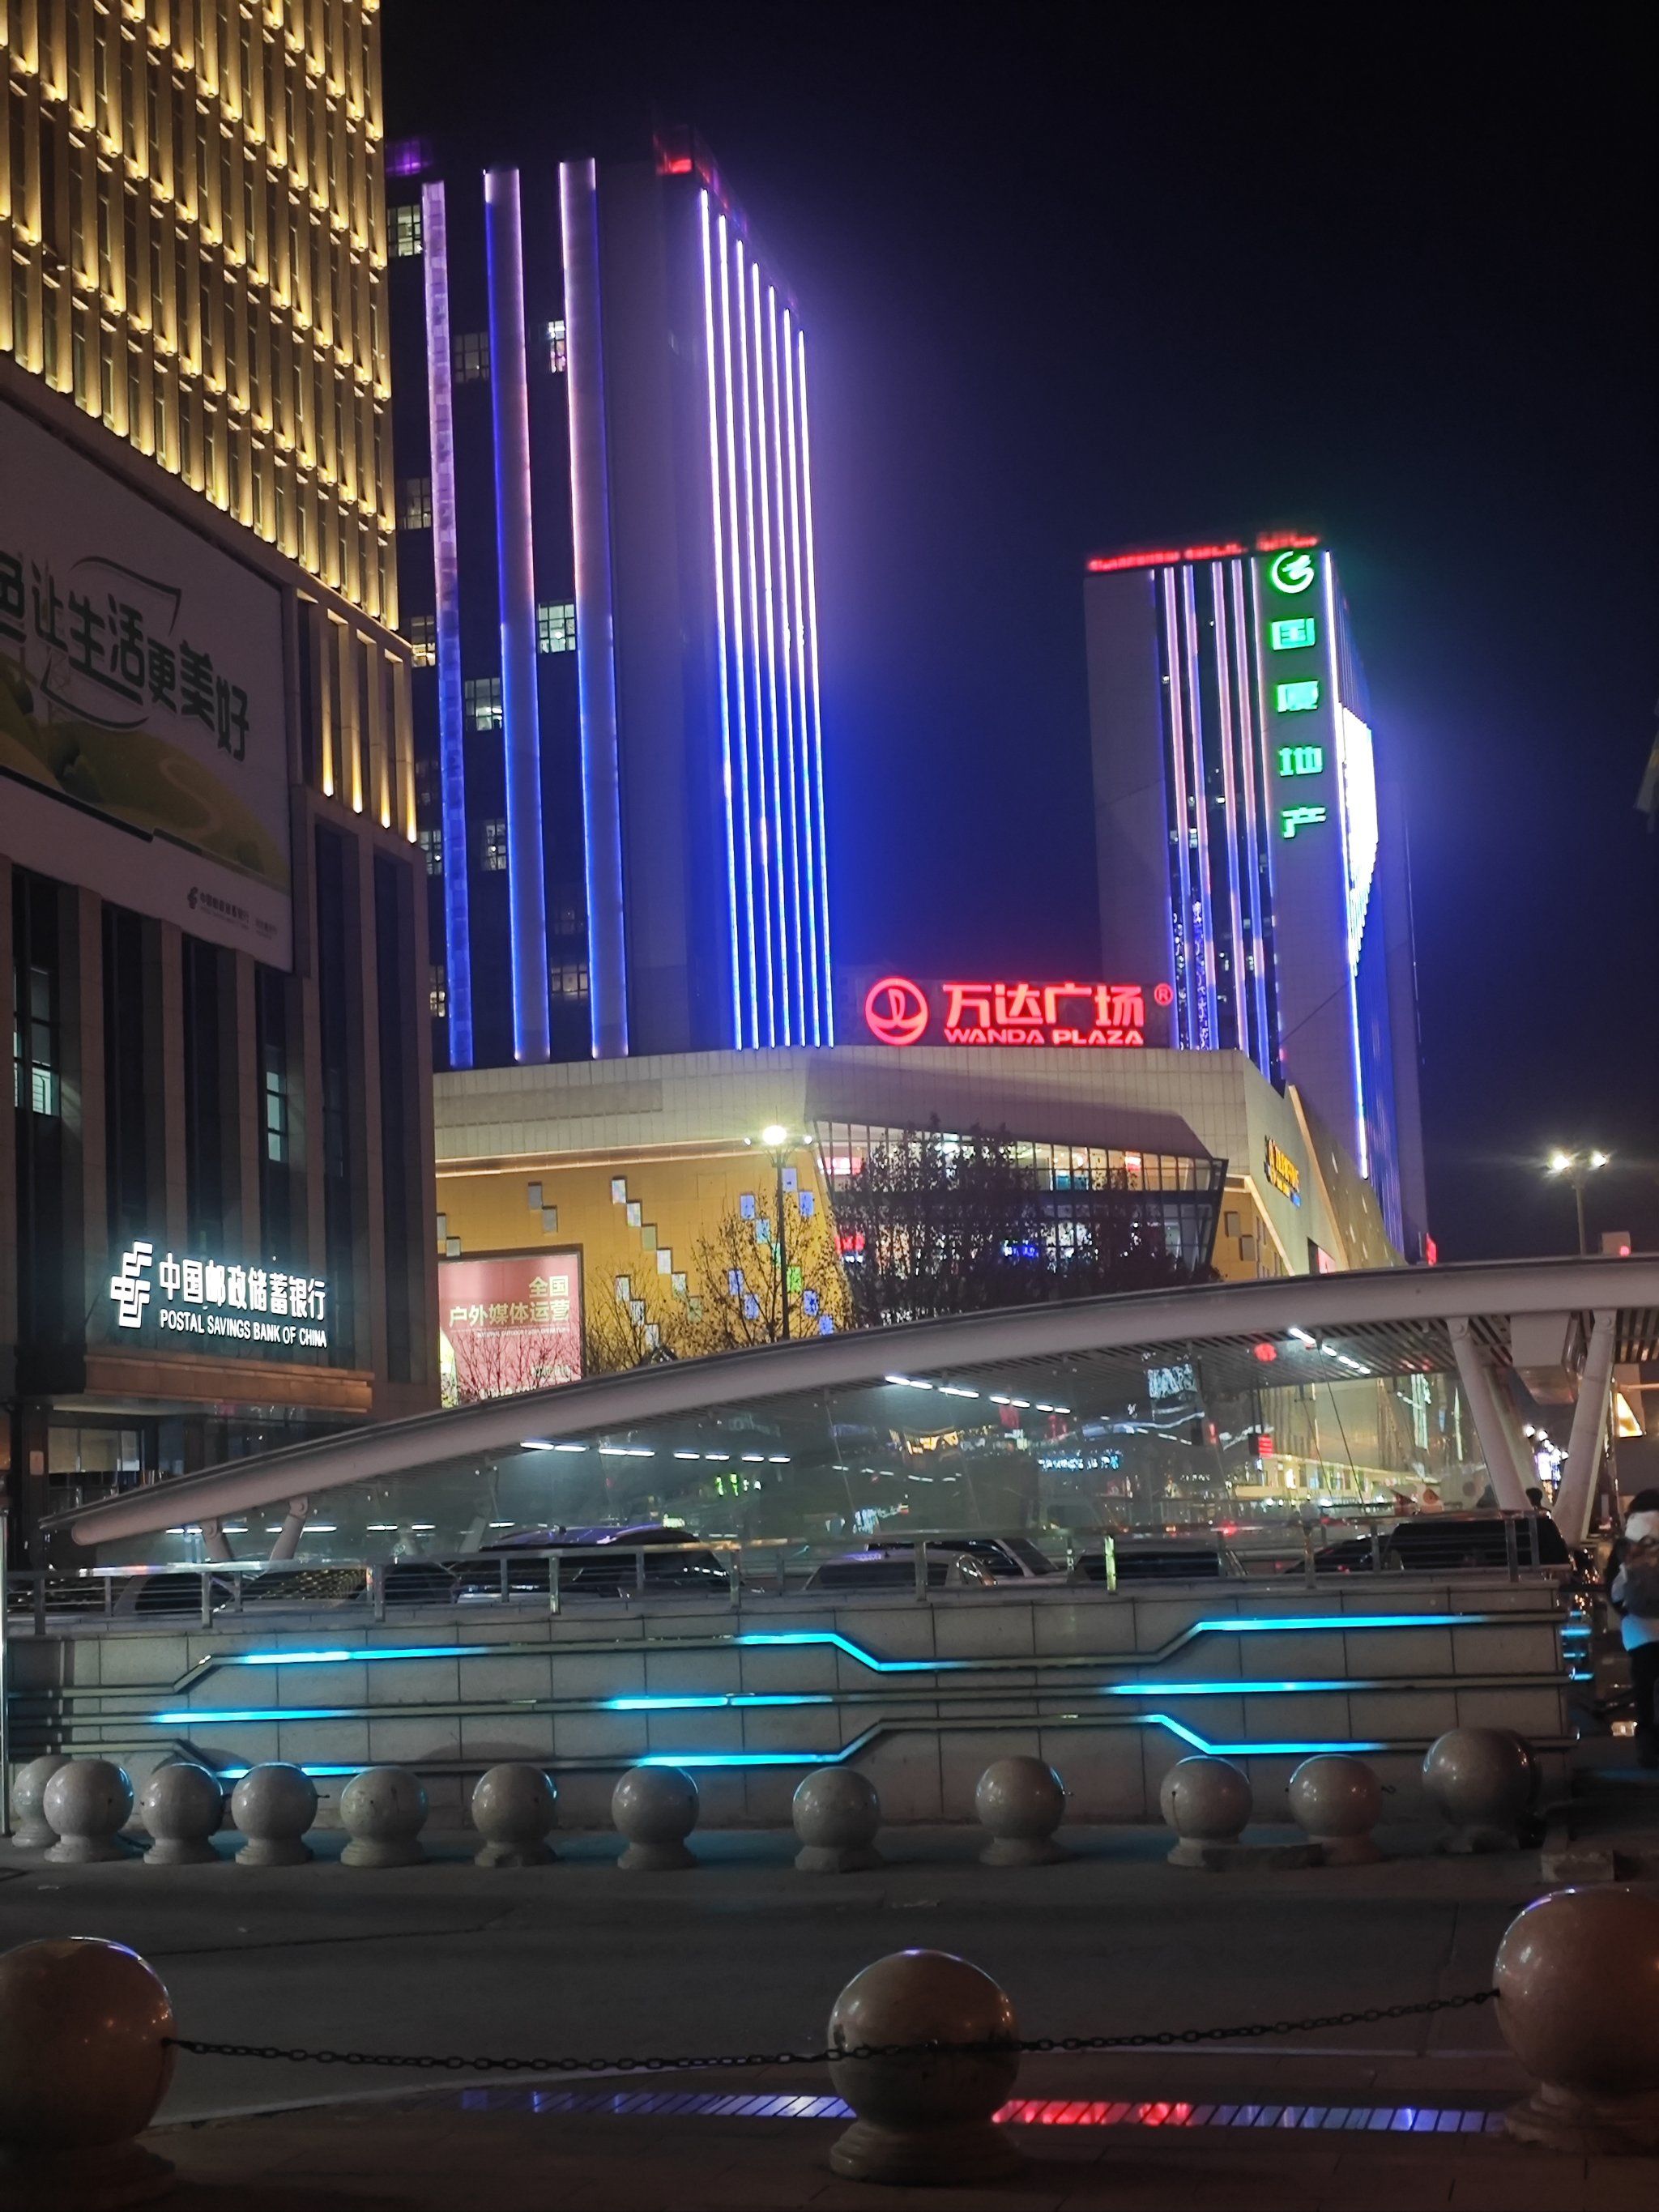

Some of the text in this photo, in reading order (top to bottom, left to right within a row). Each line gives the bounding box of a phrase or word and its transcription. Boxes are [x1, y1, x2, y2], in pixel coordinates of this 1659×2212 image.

[942, 982, 1145, 1028] 万达广场
[943, 1029, 1145, 1045] WANDA PLAZA
[159, 1252, 326, 1321] 中国邮政储蓄银行
[529, 1275, 569, 1298] 全国
[160, 1308, 327, 1349] POSTAL SAVINGS BANK OF CHINA
[449, 1299, 570, 1328] 户外媒体运营
